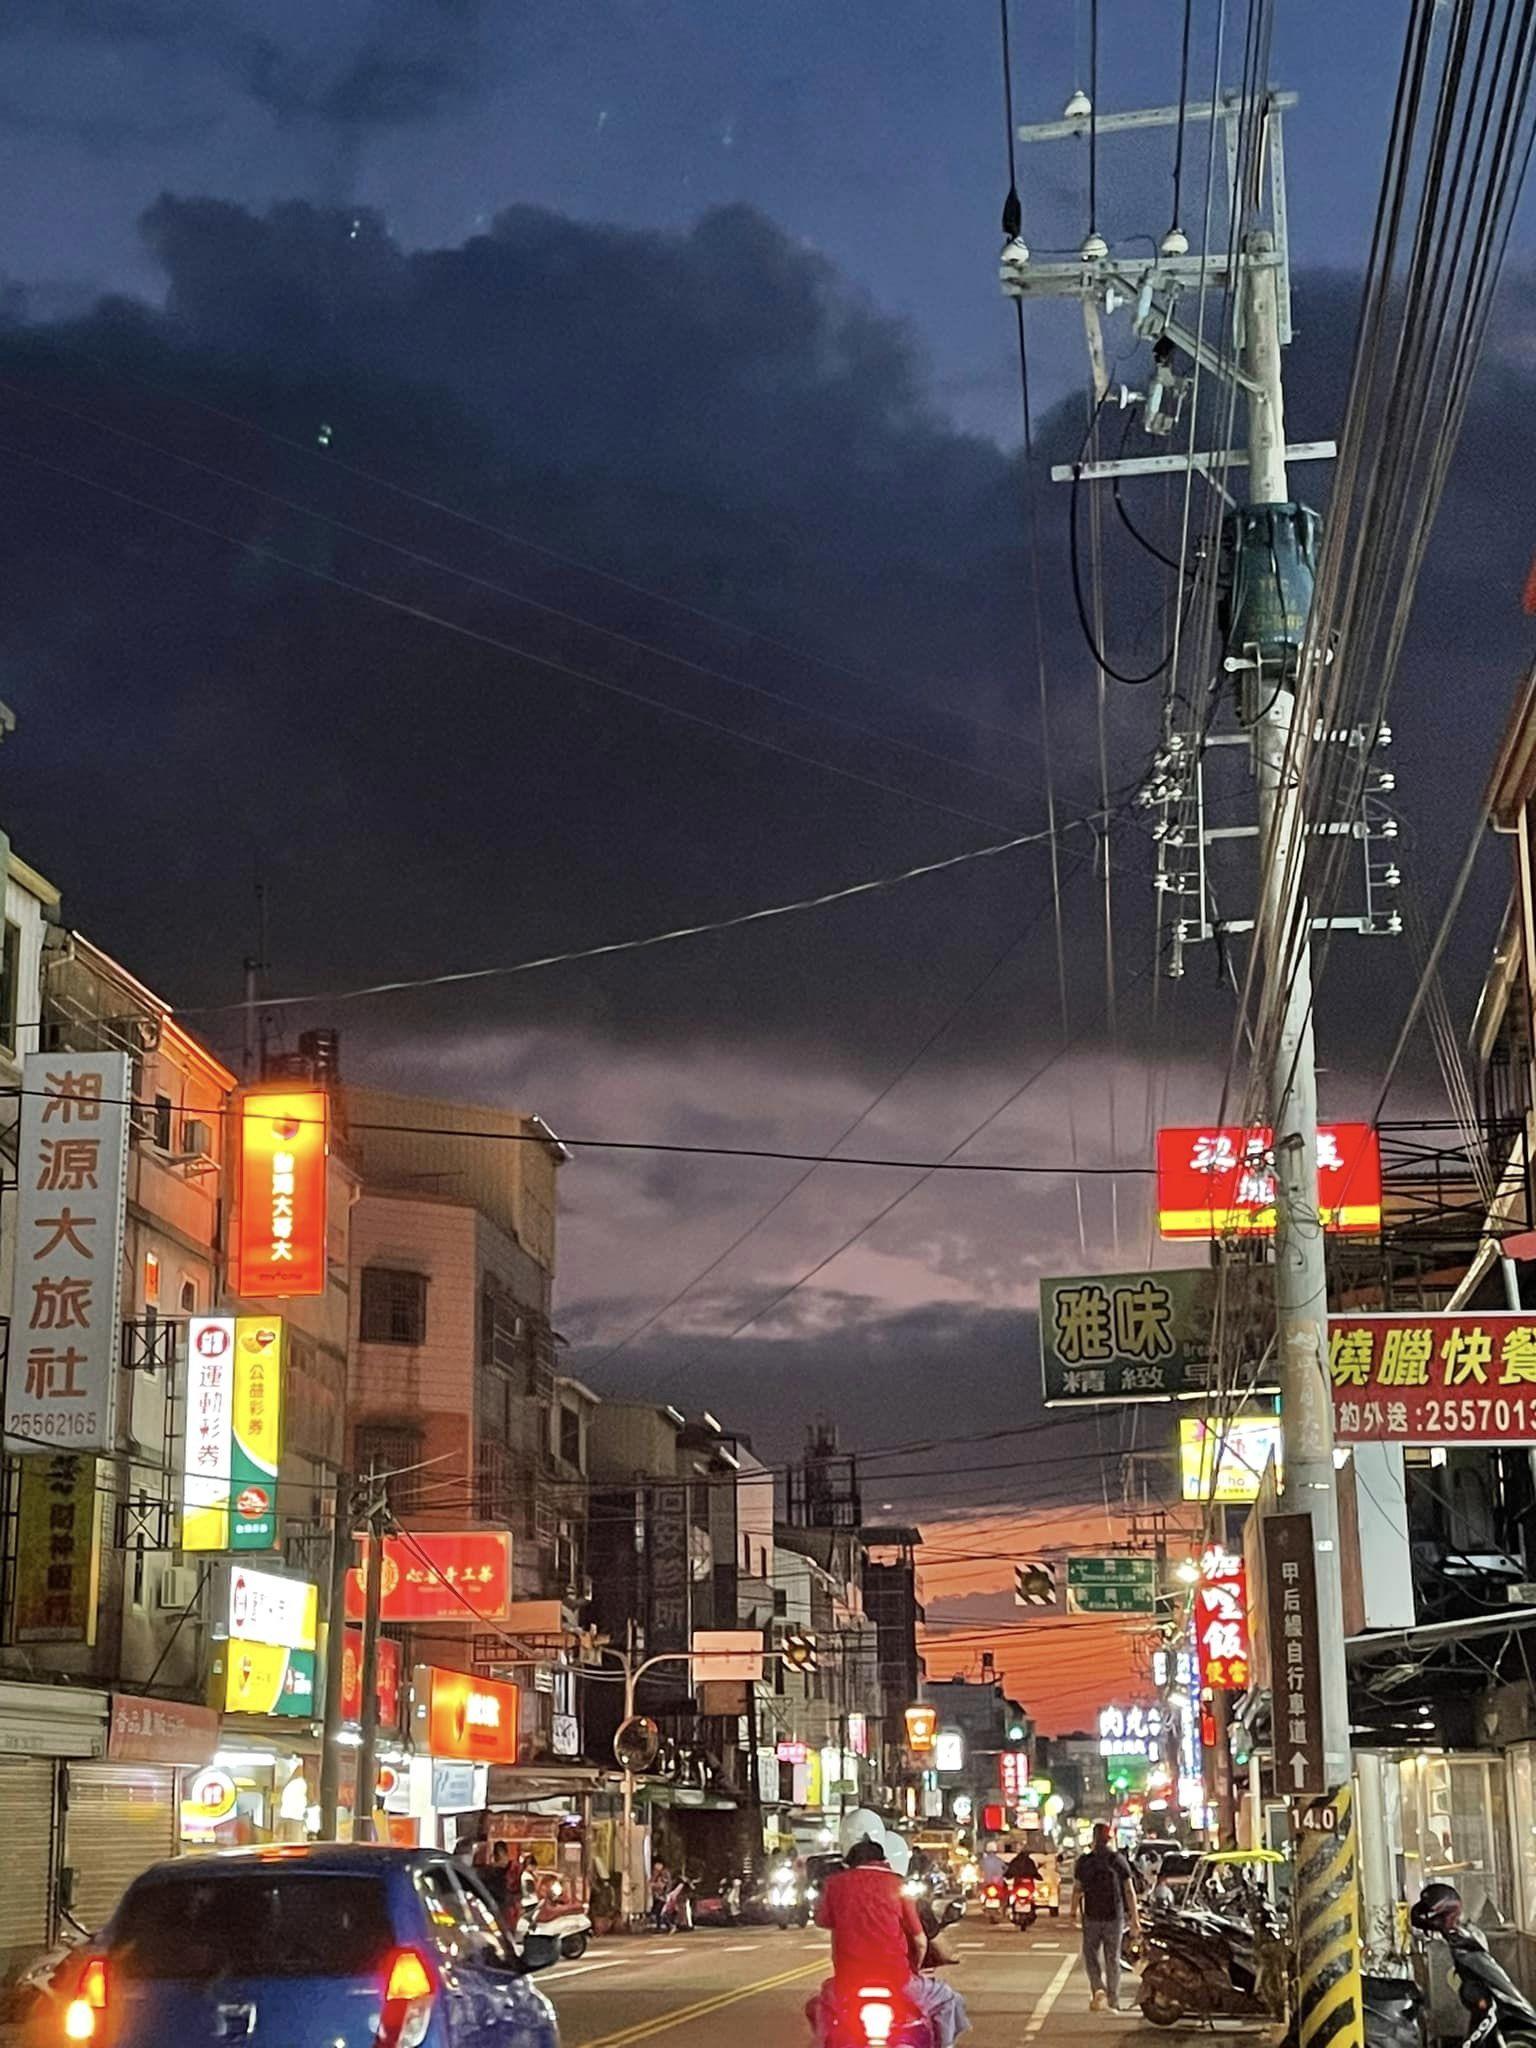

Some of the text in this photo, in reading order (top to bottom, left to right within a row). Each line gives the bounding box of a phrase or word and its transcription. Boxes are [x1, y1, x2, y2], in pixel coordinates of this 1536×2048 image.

[26, 1070, 102, 1399] 湘源大旅社
[1055, 1281, 1173, 1362] 雅味
[1329, 1326, 1536, 1387] 燒臘快餐
[10, 1411, 97, 1437] 25562165
[247, 1363, 265, 1436] 公益彩券
[1282, 1561, 1308, 1745] 甲后線自行車道
[1291, 1809, 1335, 1830] 14.0
